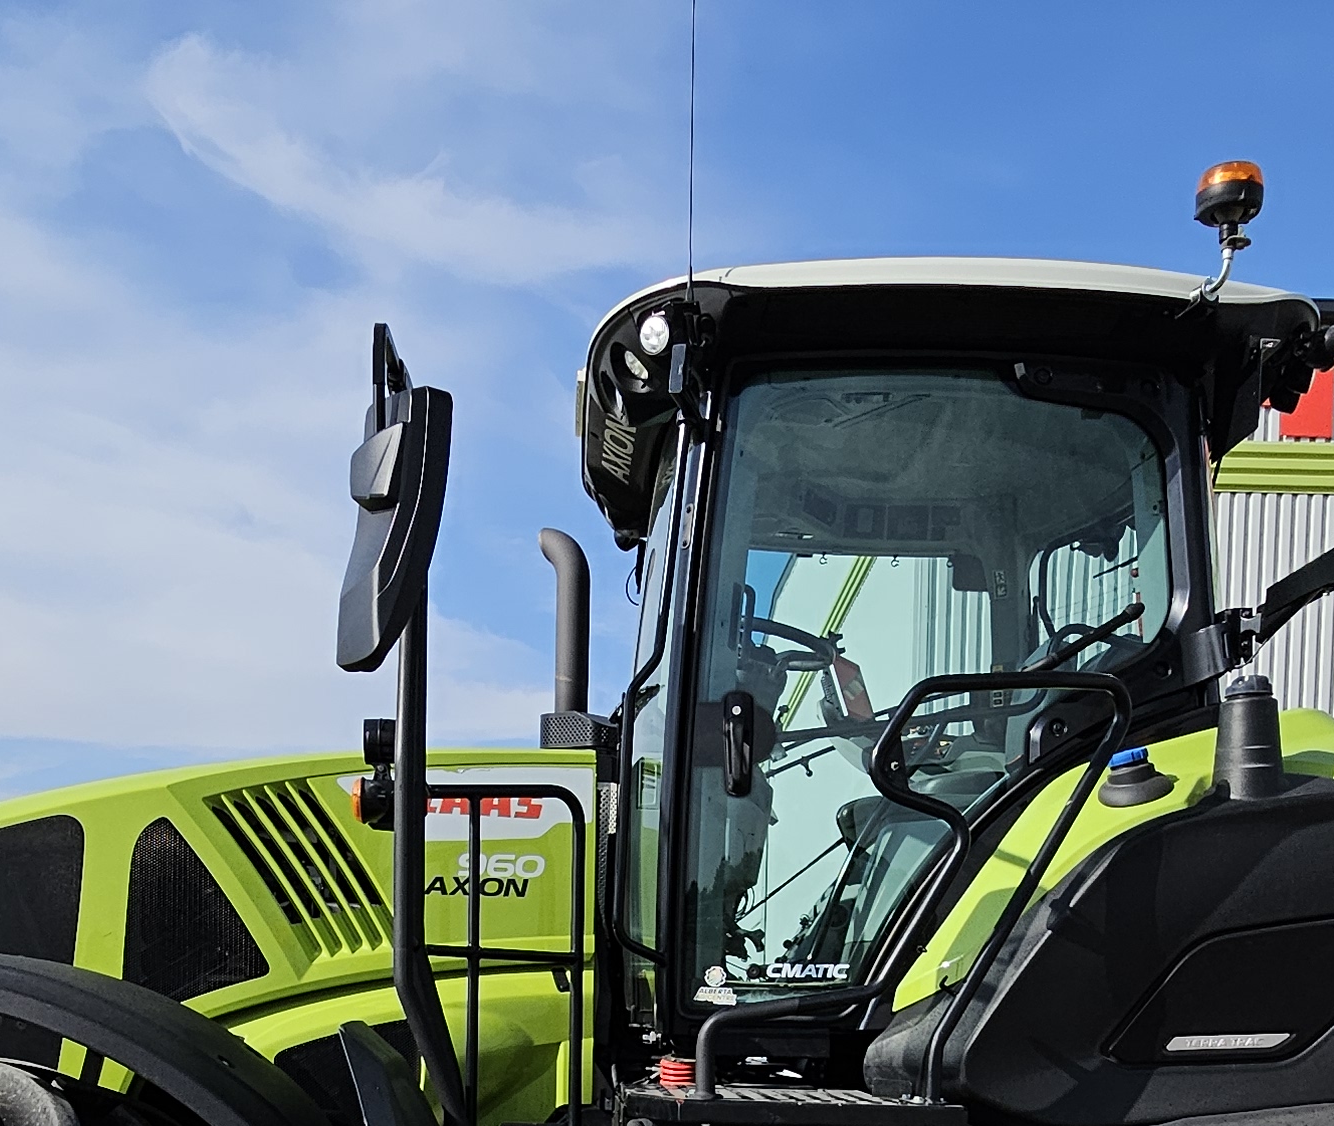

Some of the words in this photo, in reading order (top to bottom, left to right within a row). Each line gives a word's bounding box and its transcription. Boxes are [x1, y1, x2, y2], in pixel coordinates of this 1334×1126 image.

[601, 412, 637, 485] AXION
[426, 797, 543, 819] AAS
[457, 853, 546, 878] 960
[424, 876, 529, 898] AXON
[767, 963, 850, 979] CMATIC
[1186, 1039, 1226, 1048] TERRA
[1231, 1037, 1265, 1047] TRAC
